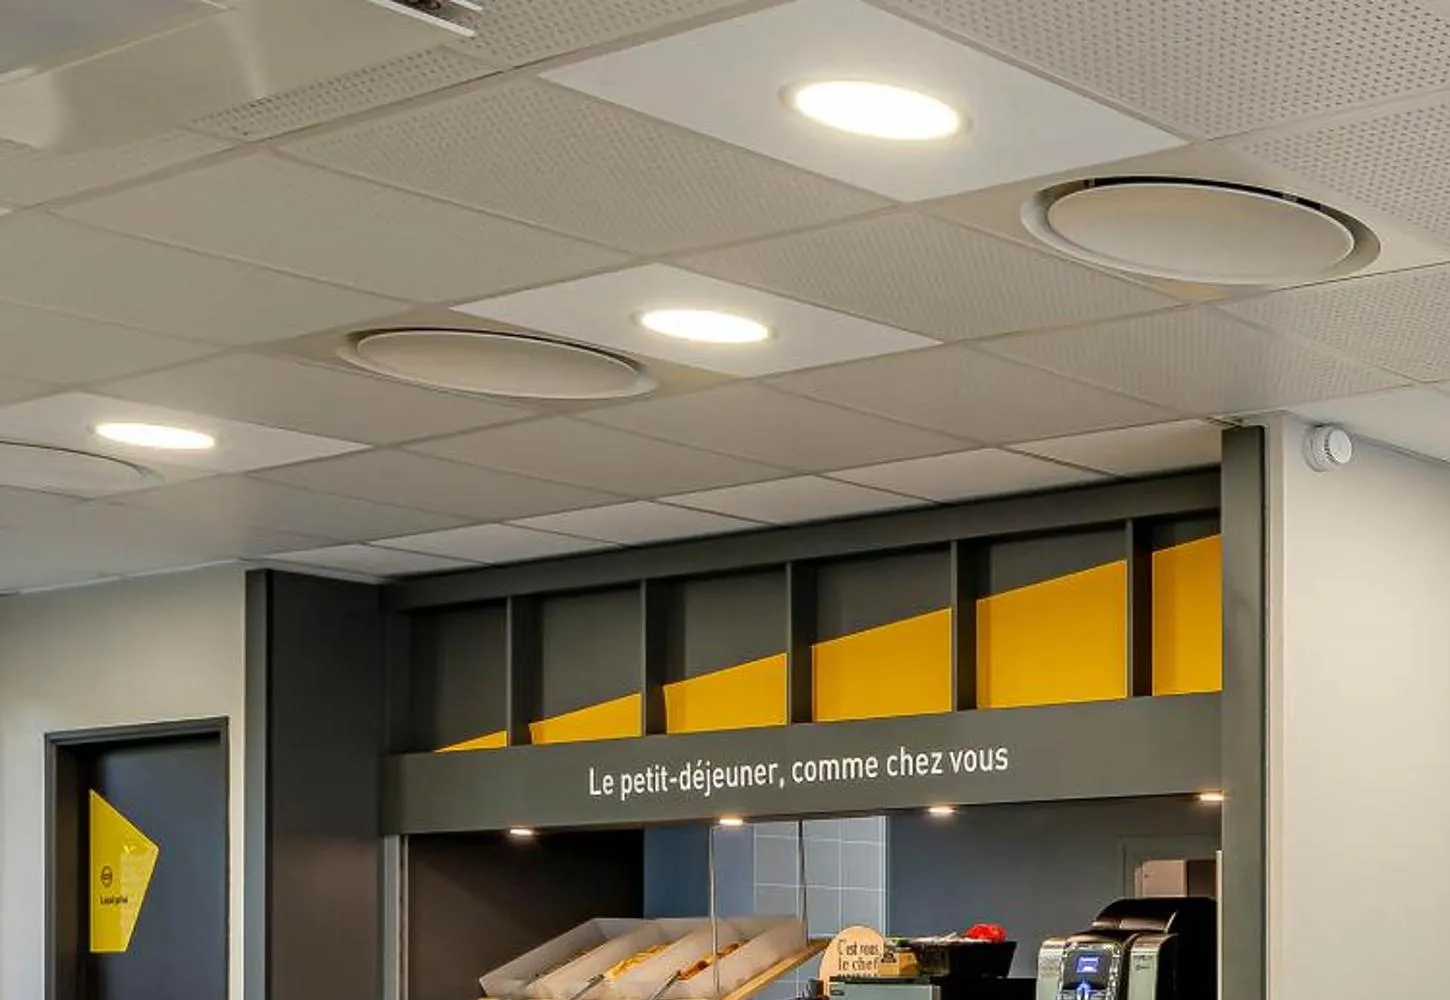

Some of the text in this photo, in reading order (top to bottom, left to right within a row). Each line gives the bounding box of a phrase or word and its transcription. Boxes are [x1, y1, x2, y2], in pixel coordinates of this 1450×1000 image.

[589, 746, 1009, 801] Le petit-déjeuner, comme chez vous
